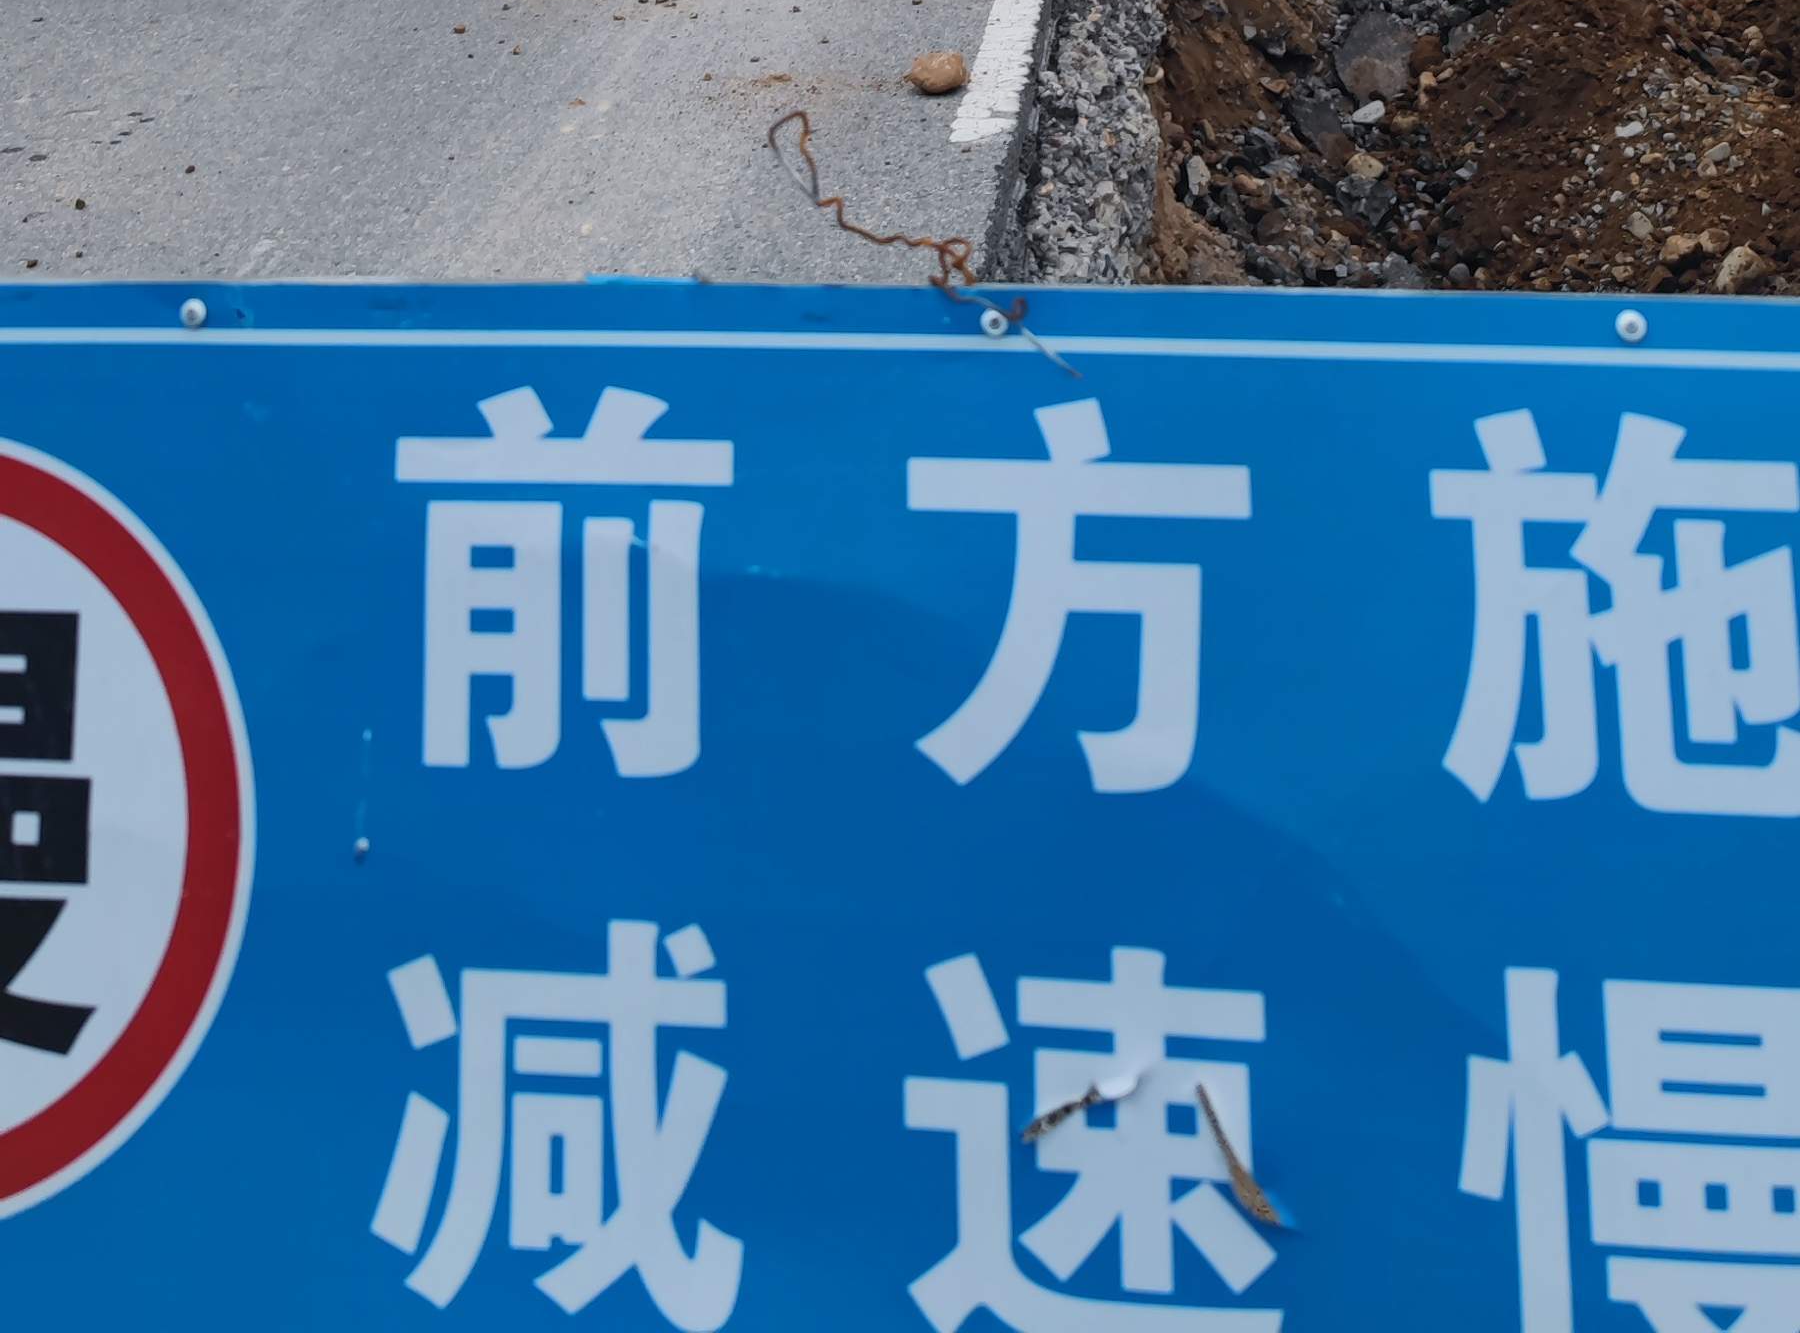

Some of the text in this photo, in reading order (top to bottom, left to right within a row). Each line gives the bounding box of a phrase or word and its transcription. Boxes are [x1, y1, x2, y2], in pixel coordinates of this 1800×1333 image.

[394, 386, 1800, 818] 前方施
[369, 918, 1800, 1333] 减速慢
